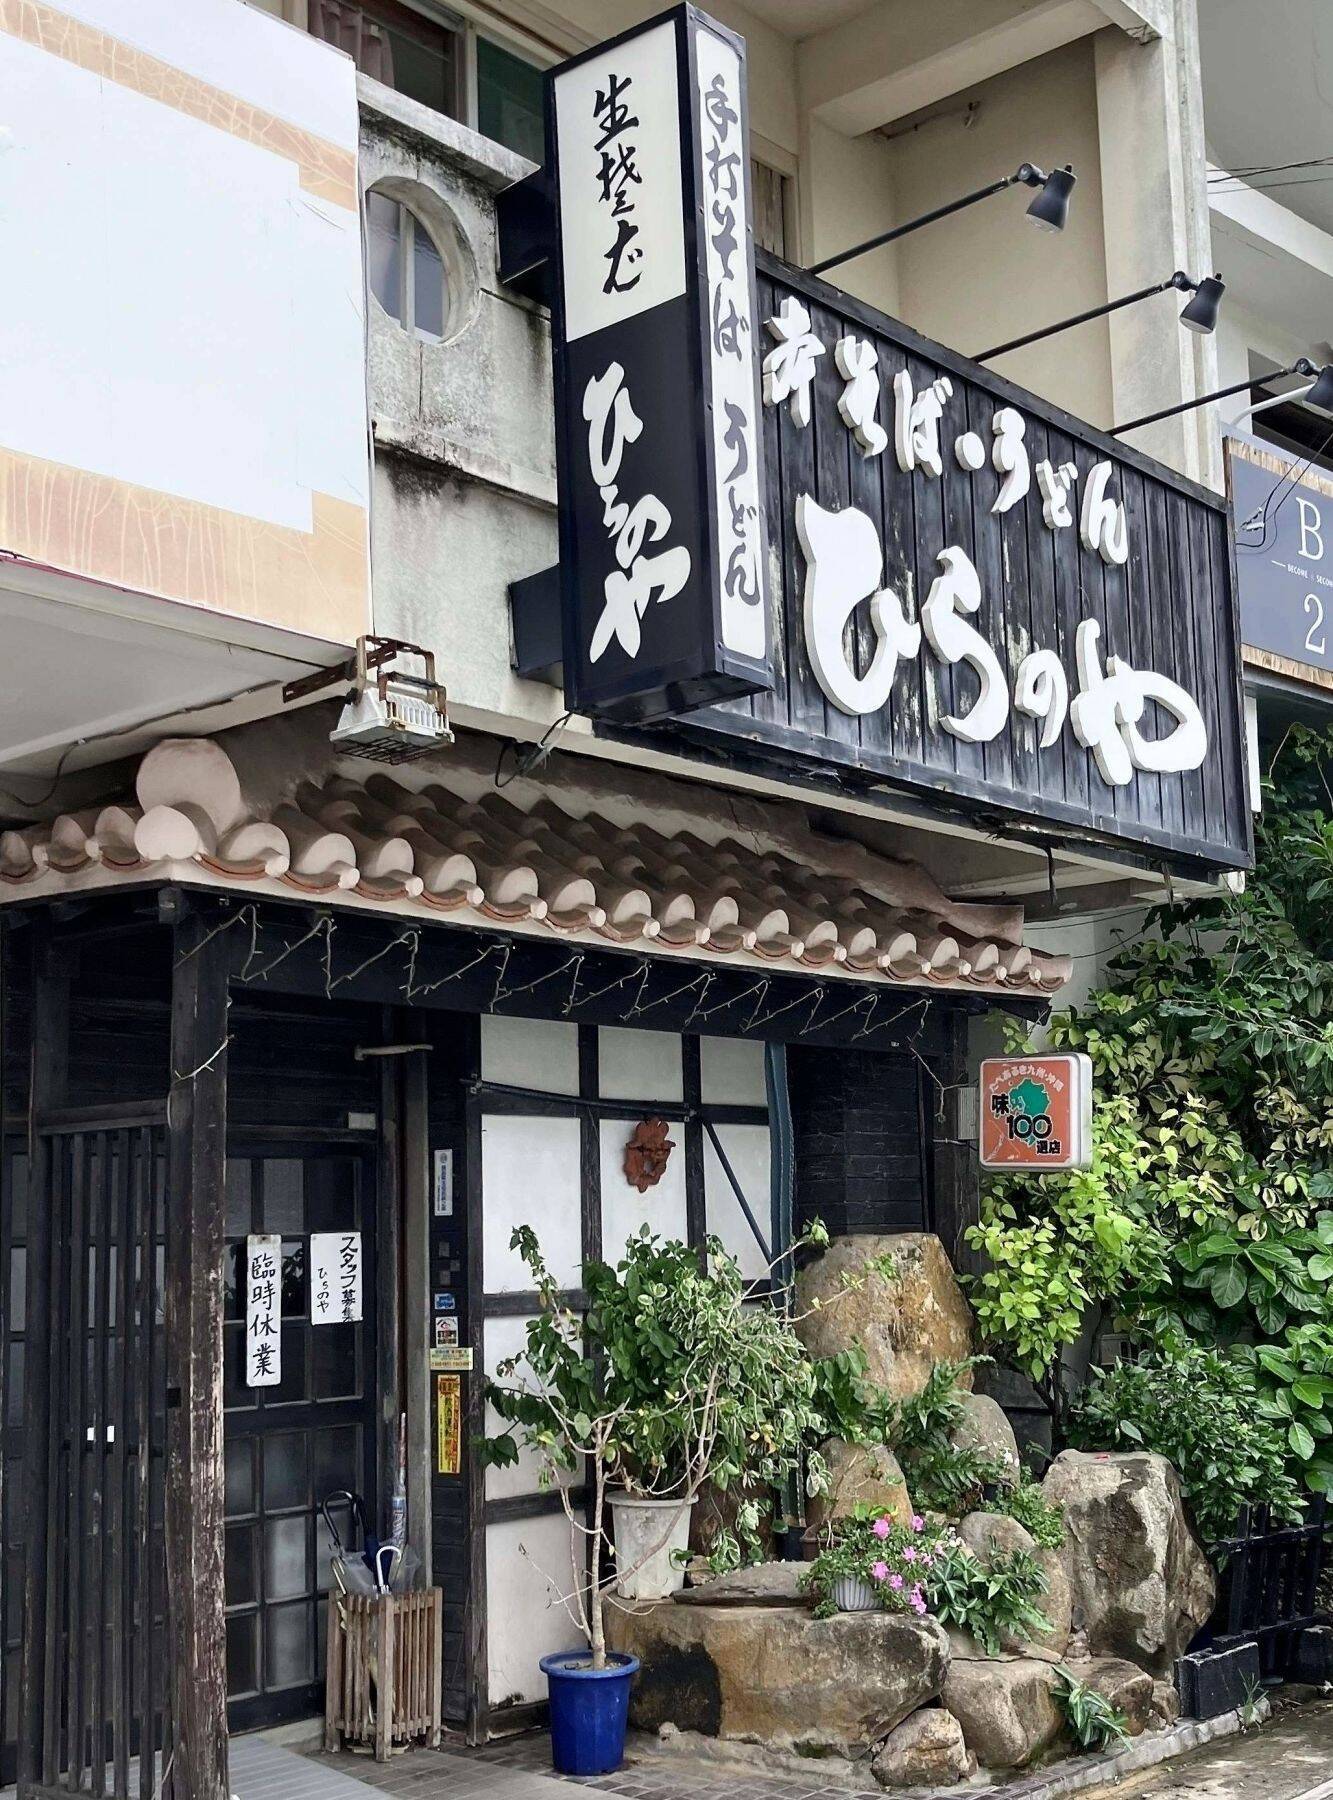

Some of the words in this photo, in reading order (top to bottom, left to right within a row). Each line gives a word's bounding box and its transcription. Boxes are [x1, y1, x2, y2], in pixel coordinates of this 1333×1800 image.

[582, 361, 691, 664] ひらのや
[723, 399, 761, 606] うどん
[1296, 497, 1324, 561] B
[796, 493, 1208, 786] ひらのや
[1304, 593, 1325, 655] 2
[1006, 1114, 1053, 1140] 100
[250, 1253, 278, 1377] 臨時休業
[317, 1267, 330, 1313] ひらのや
